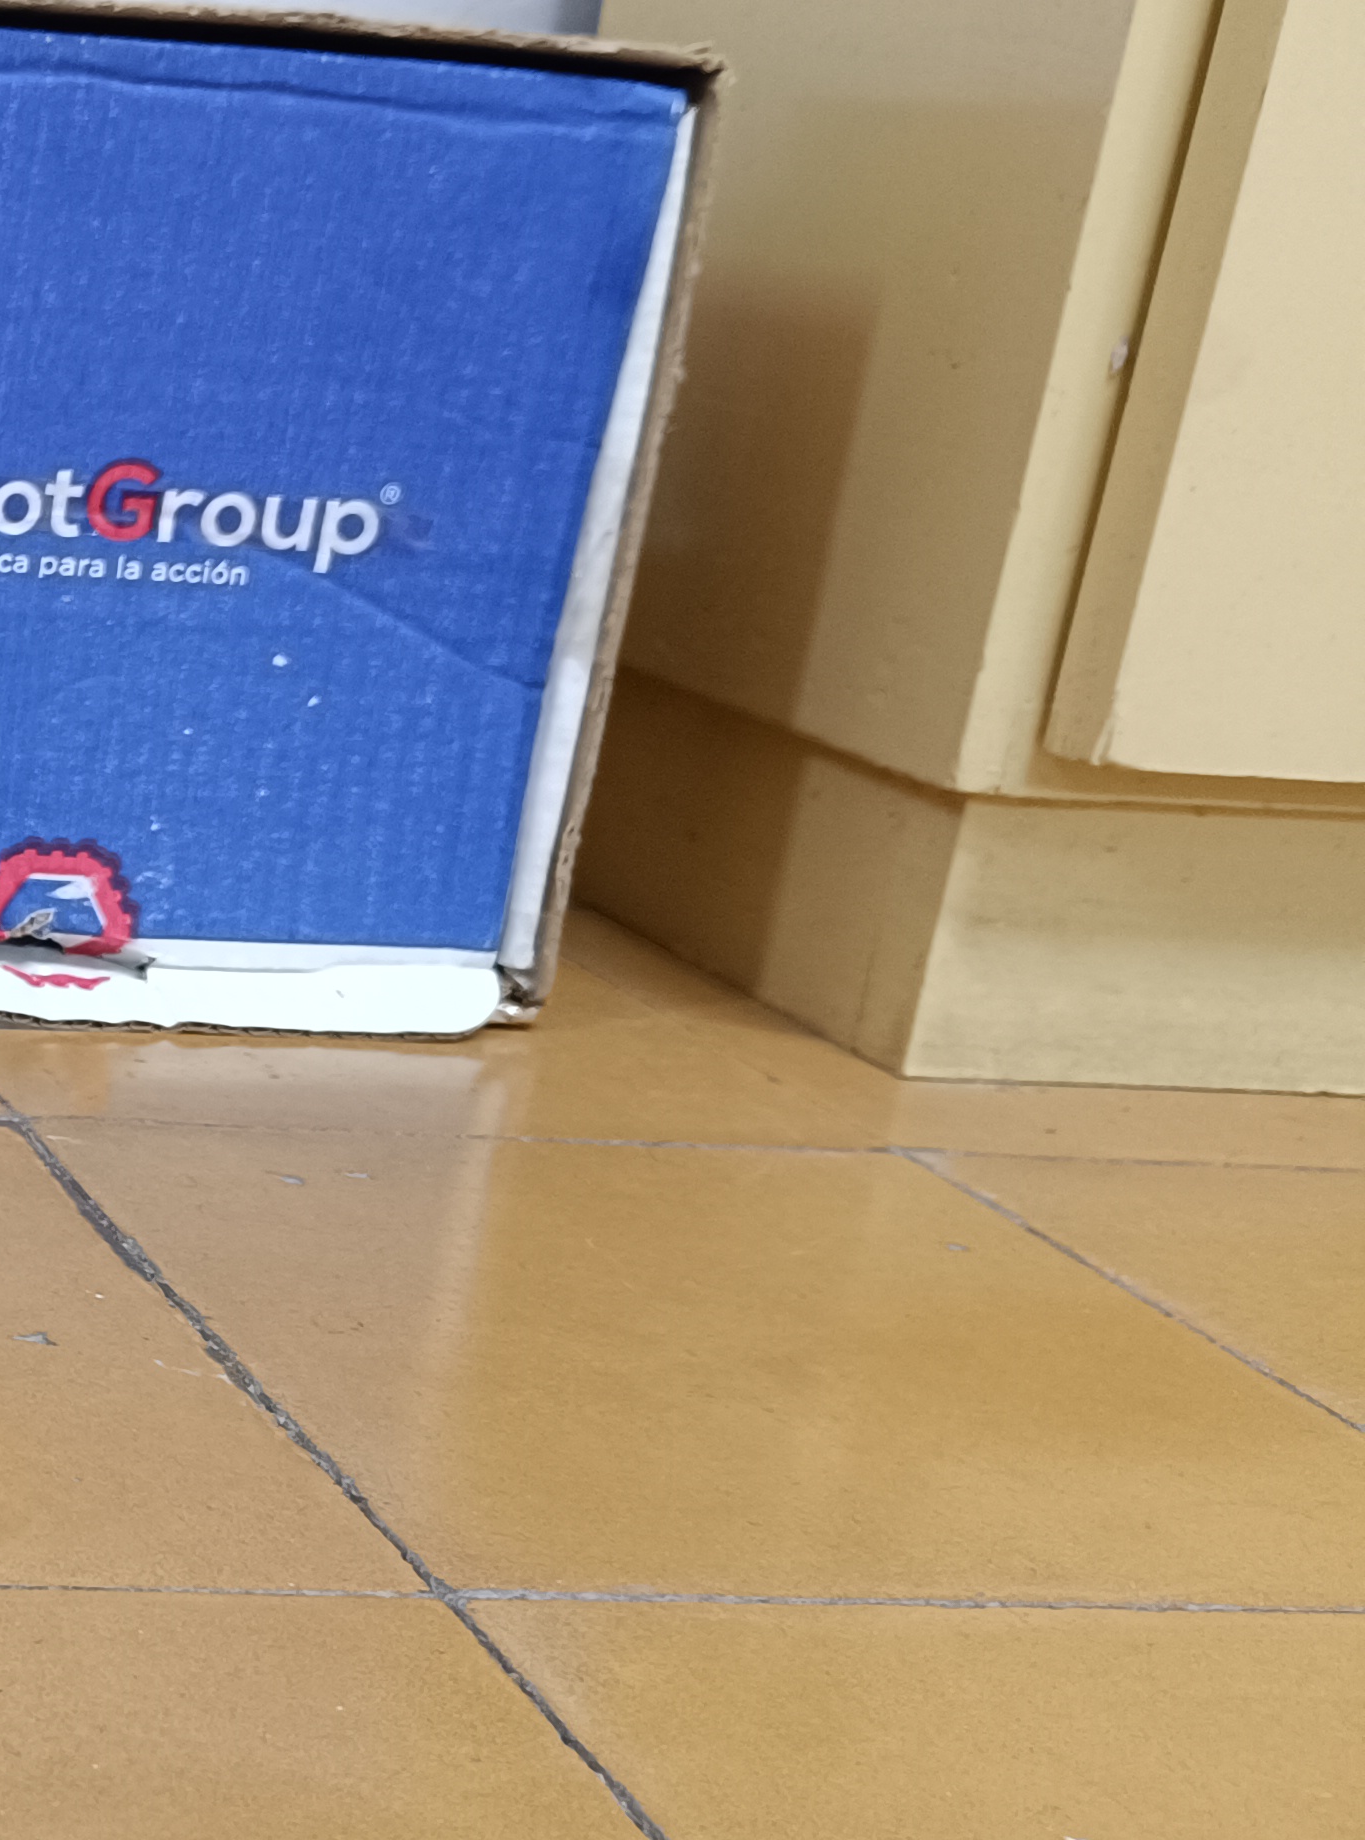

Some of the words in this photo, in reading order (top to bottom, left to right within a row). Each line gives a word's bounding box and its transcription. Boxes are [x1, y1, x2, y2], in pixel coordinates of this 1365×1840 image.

[38, 554, 107, 579] para
[116, 554, 143, 581] la
[150, 559, 250, 587] acción
